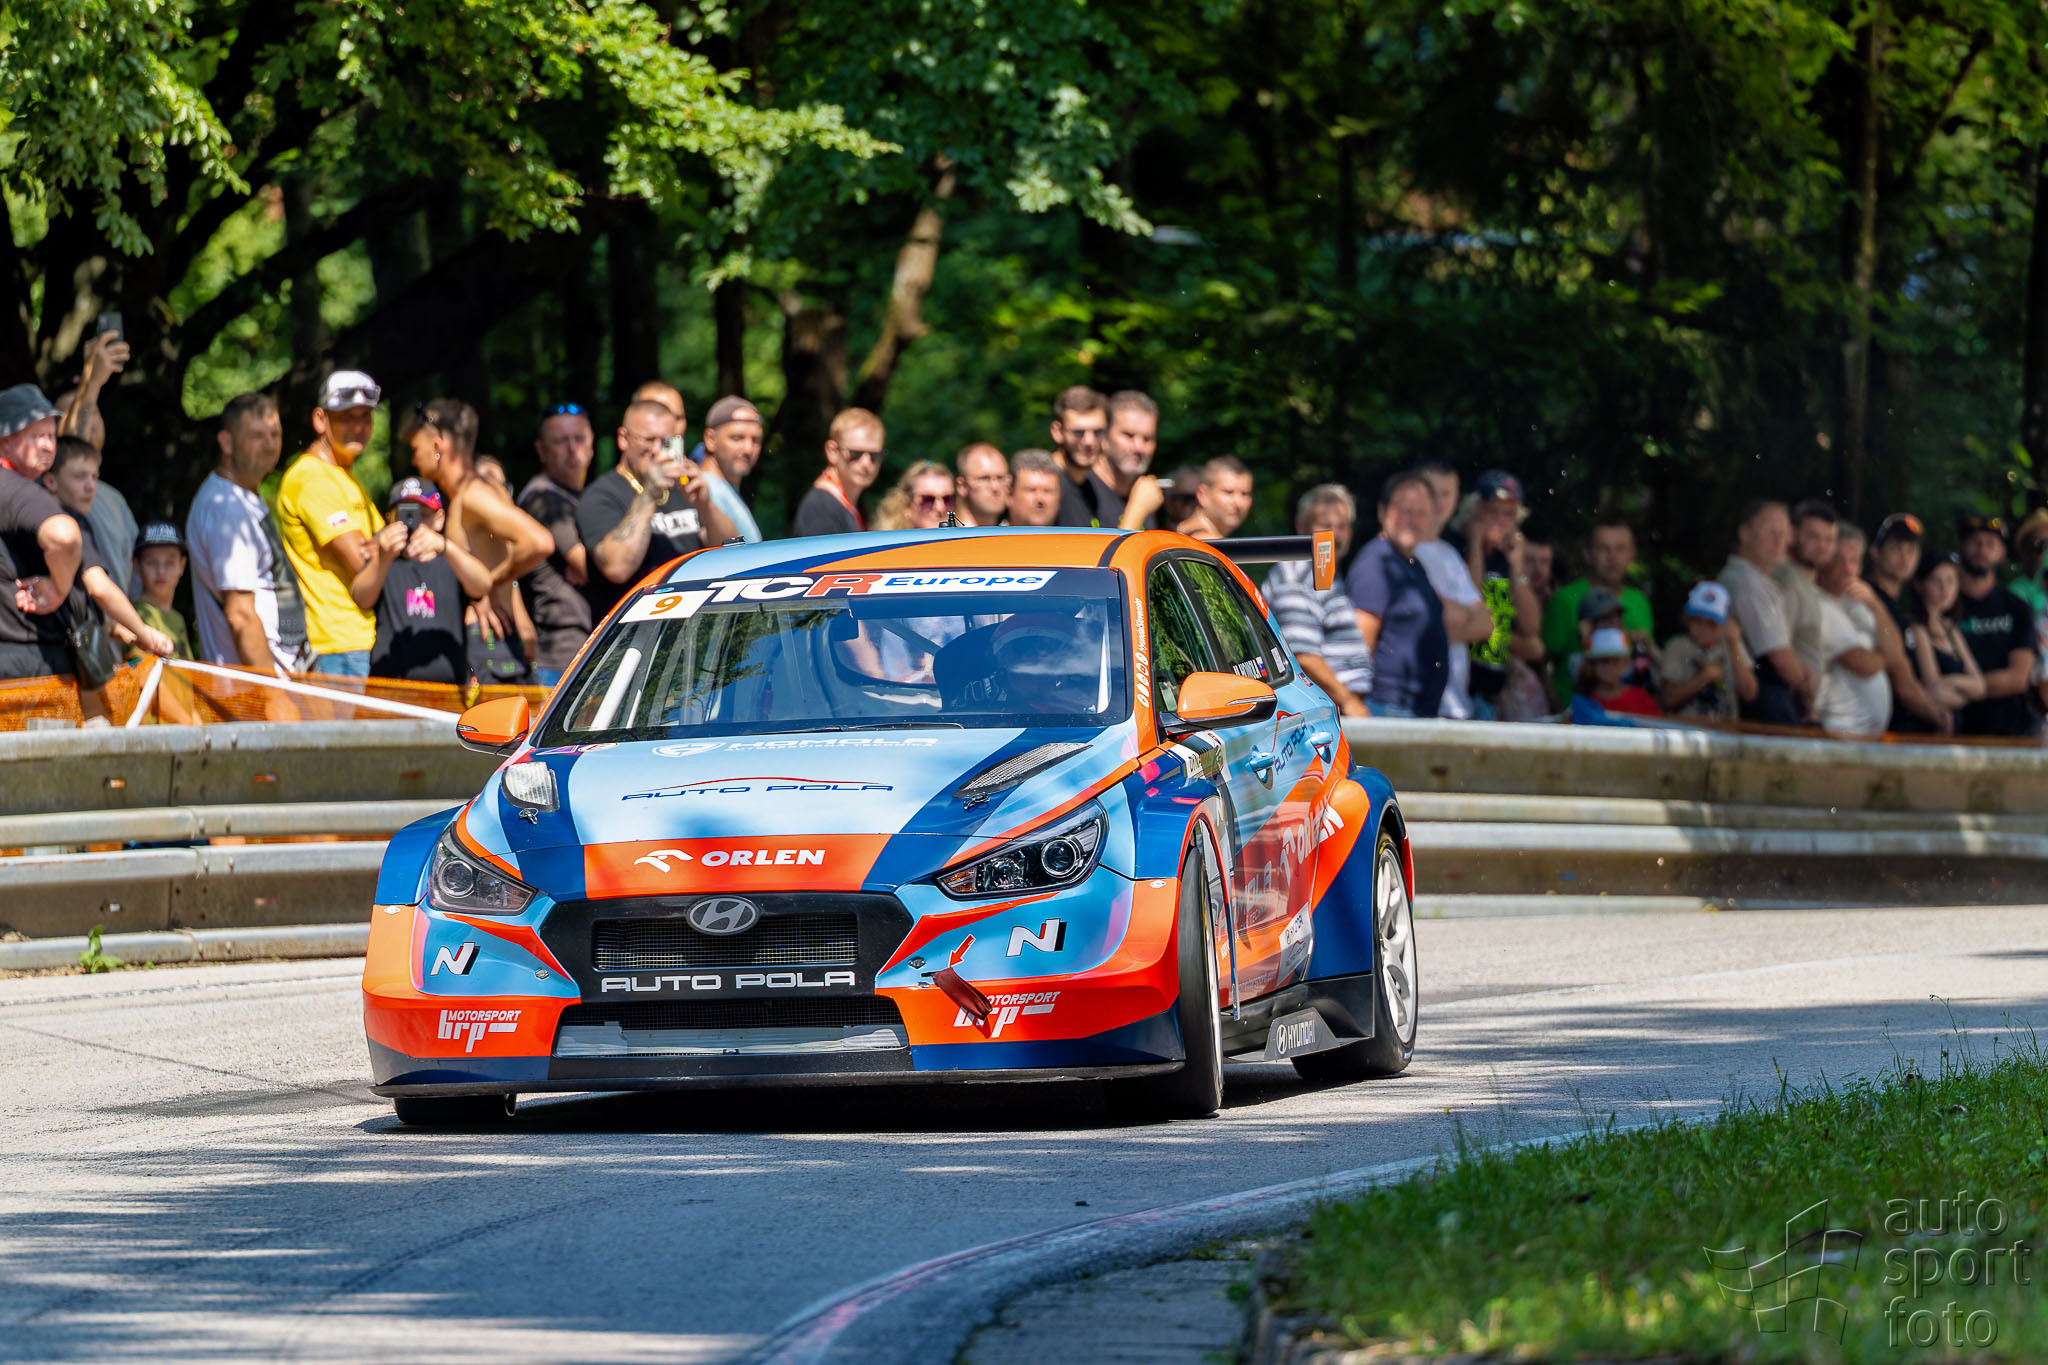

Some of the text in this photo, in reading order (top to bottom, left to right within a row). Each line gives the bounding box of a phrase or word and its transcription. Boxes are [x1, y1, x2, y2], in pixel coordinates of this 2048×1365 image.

[707, 574, 1043, 603] TCR Europe
[649, 595, 683, 616] 9
[728, 738, 939, 749] HOMOLA
[621, 784, 894, 801] AUTO POLA
[701, 849, 826, 867] ORLEN
[601, 970, 856, 993] AUTO POLA
[984, 991, 1061, 1006] OTORSPORT
[448, 1010, 522, 1021] MOTORSPORT
[437, 1009, 488, 1053] brp
[1287, 1019, 1316, 1050] HYUNDAI
